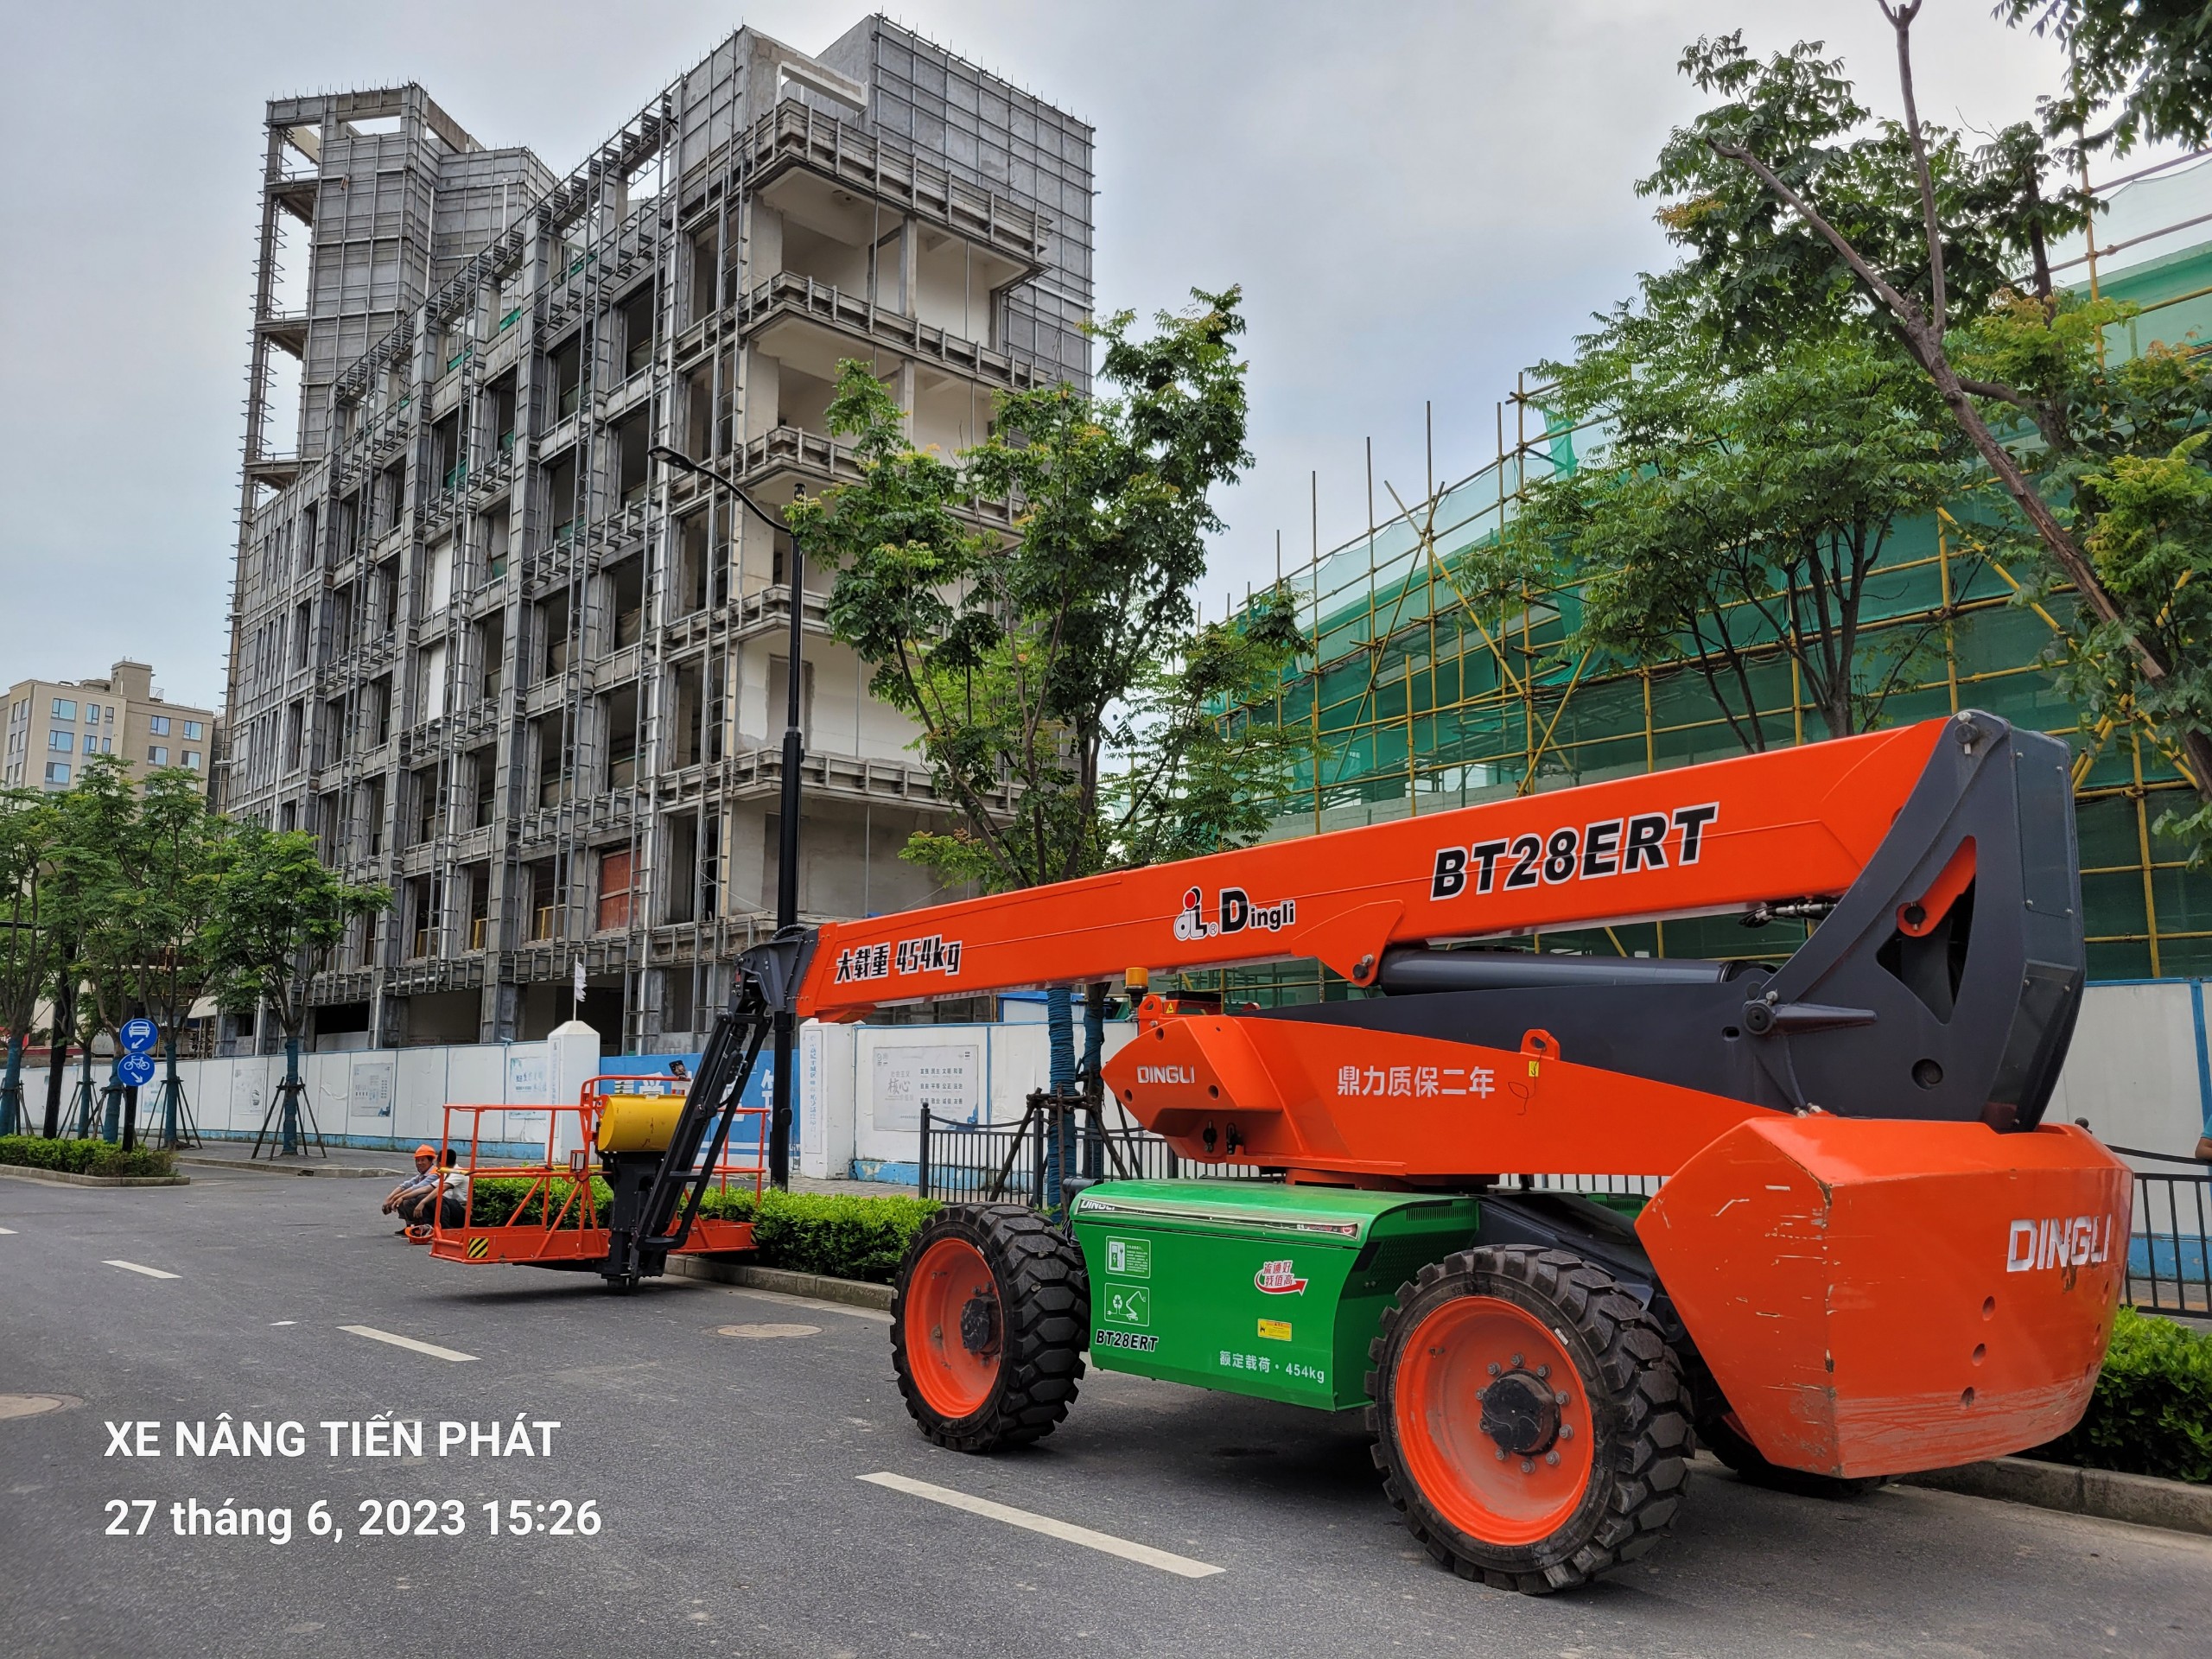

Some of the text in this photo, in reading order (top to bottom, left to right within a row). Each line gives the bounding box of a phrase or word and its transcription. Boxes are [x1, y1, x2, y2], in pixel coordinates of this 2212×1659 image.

[1430, 802, 1719, 901] BT28ERT
[1220, 887, 1295, 932] Dingli
[834, 934, 963, 984] 大载重 454kg
[1137, 1065, 1195, 1084] DINGLI
[1338, 1065, 1495, 1099] 鼎力质保二年
[2006, 1214, 2112, 1272] DINGLI
[1263, 1262, 1292, 1274] 流通好
[1096, 1329, 1159, 1352] BT28ERT
